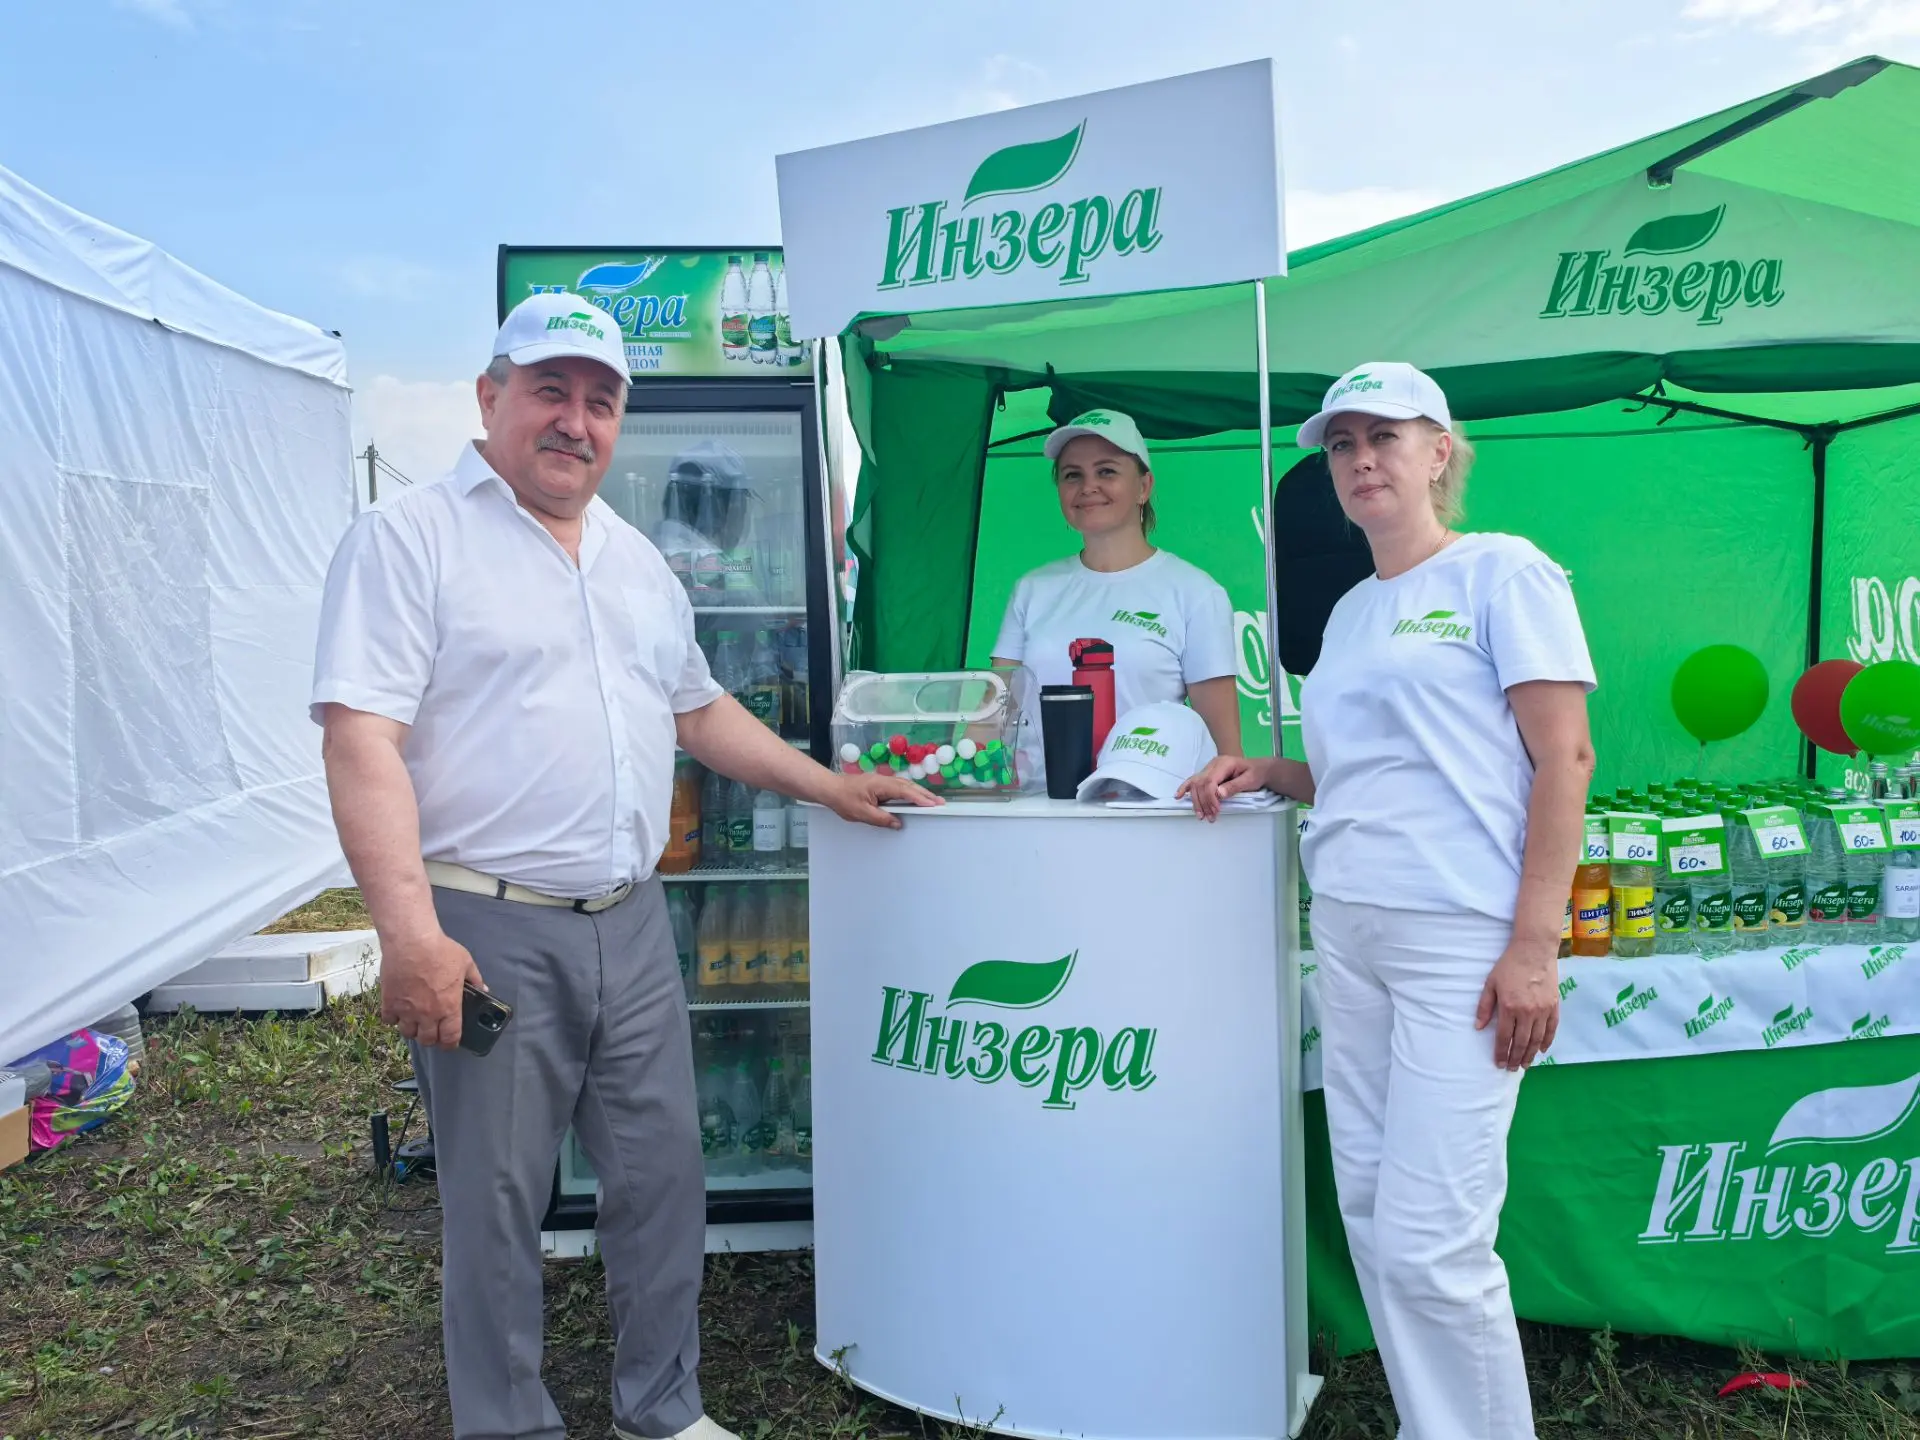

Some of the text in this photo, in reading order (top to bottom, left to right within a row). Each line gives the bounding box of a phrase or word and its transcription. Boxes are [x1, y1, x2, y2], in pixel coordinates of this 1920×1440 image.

[877, 186, 1163, 290] Инзера
[1539, 249, 1785, 326] Инзера
[545, 316, 605, 341] Инзера
[1331, 378, 1384, 403] Инзера
[1110, 609, 1167, 638] Инзера
[1390, 617, 1473, 641] Инзера
[1111, 732, 1171, 758] Инзера
[1603, 985, 1658, 1028] Инзера
[1683, 996, 1735, 1039] Инзера
[1761, 1006, 1814, 1048] Инзера
[871, 985, 1158, 1110] Инзера
